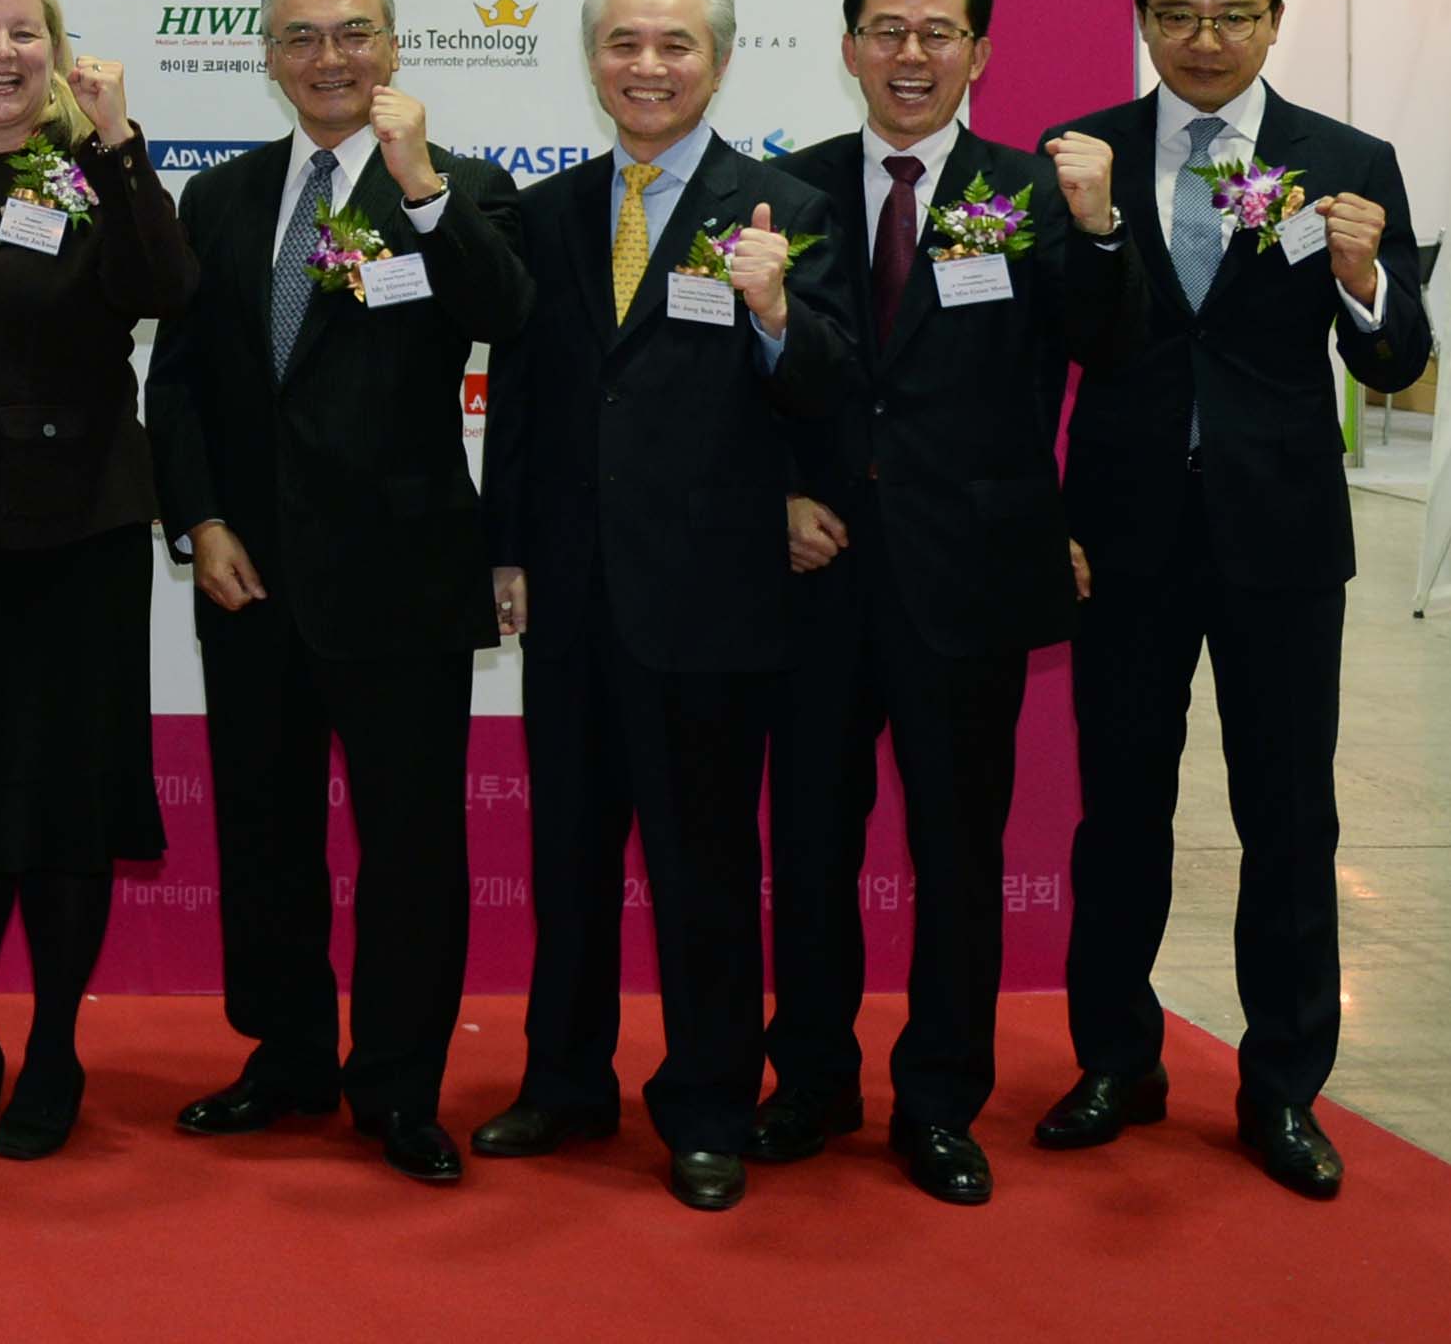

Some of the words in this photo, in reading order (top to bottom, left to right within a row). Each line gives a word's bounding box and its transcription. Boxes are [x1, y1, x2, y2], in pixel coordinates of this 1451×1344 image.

[156, 6, 265, 36] HIWI
[426, 29, 538, 55] Technology
[423, 56, 464, 68] remote
[466, 55, 539, 70] professionals
[472, 876, 528, 908] 2014
